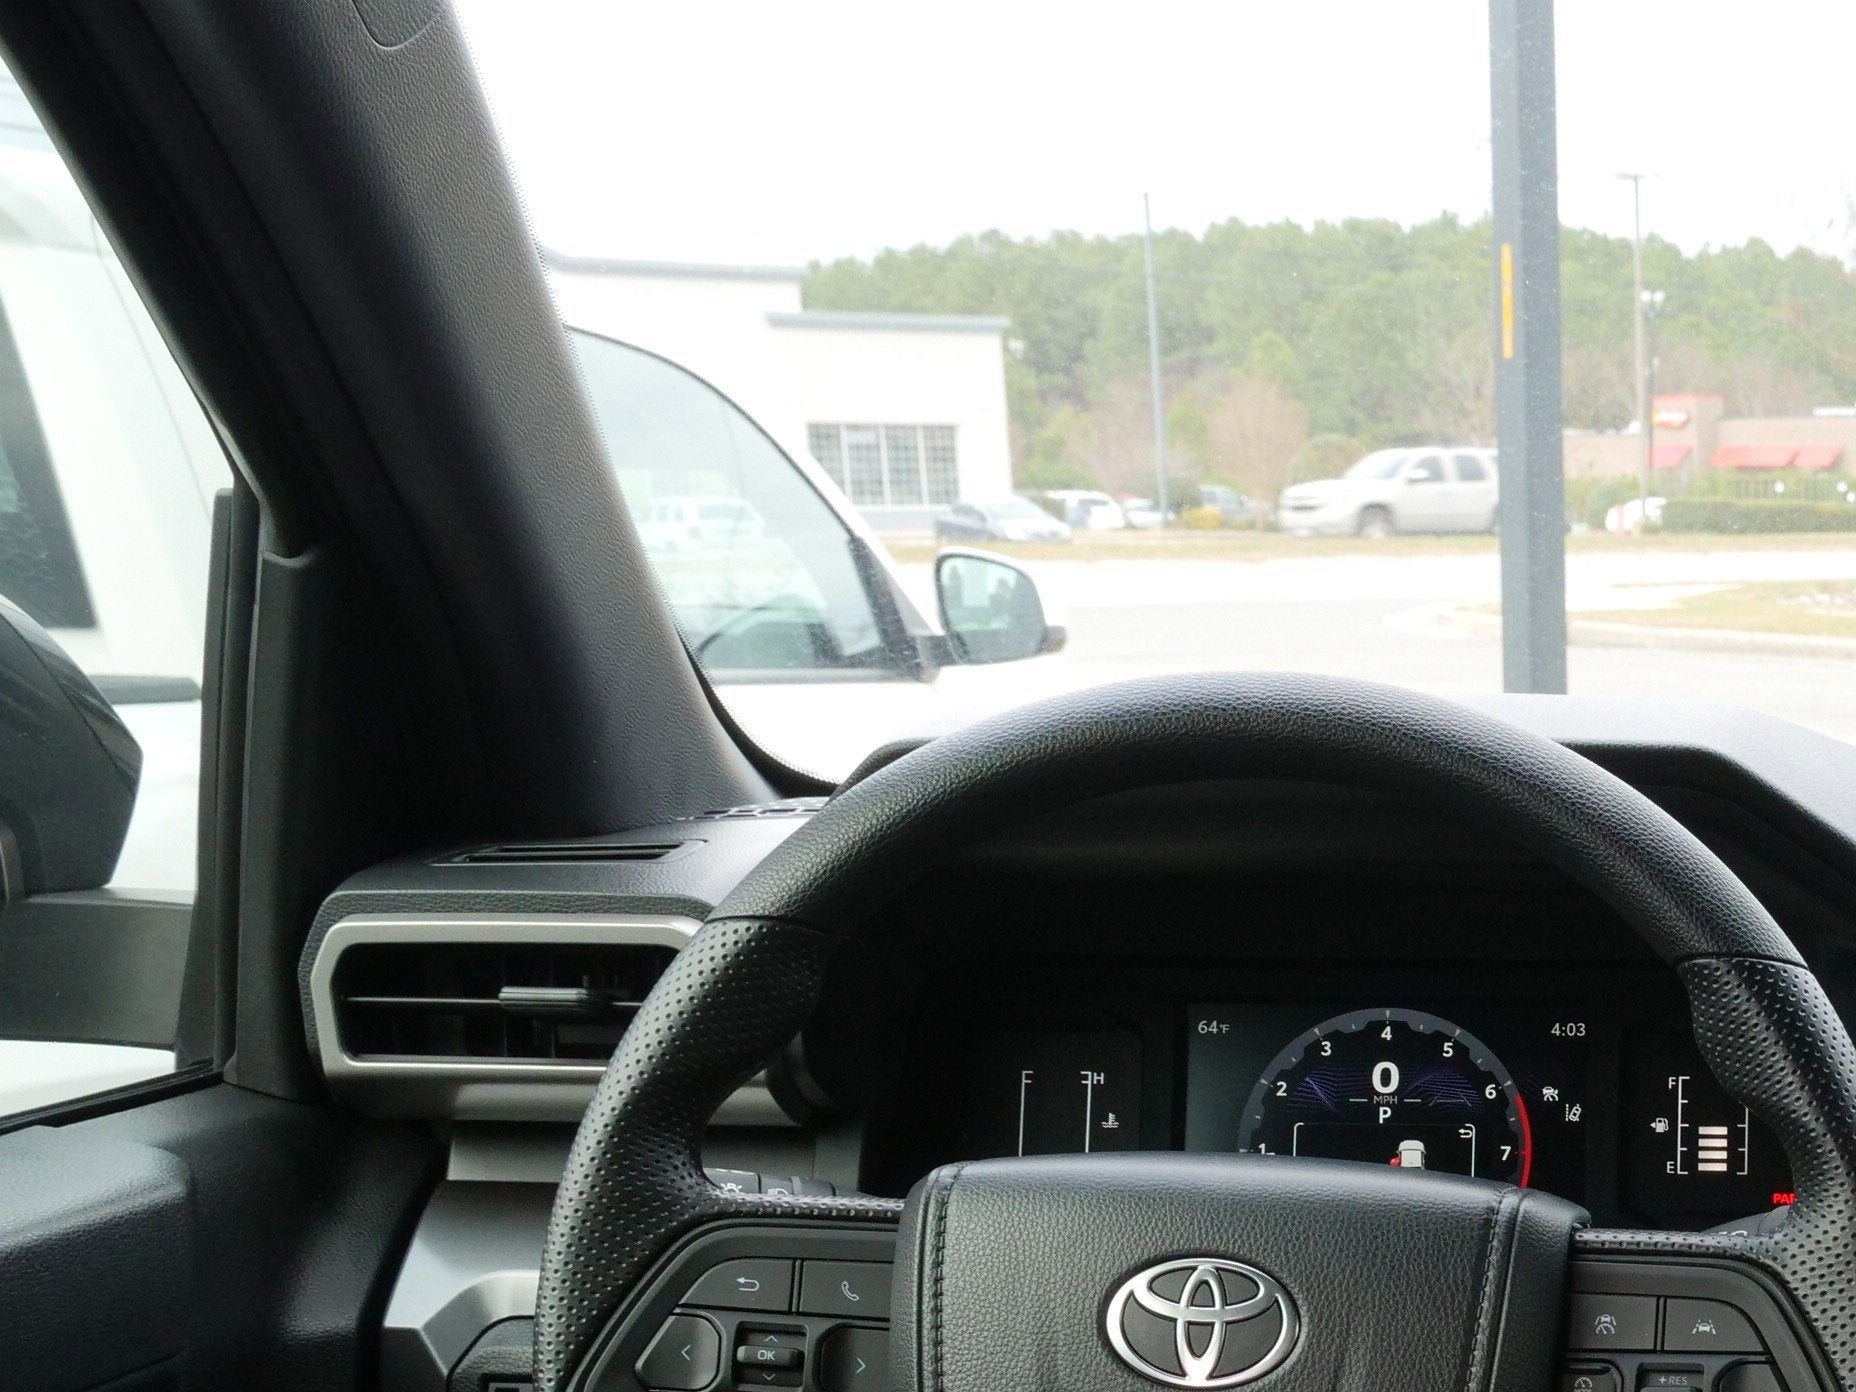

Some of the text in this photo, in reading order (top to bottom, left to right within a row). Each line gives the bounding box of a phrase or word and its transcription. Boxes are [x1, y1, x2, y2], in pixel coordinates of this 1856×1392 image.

[1381, 1026, 1392, 1041] 4
[1551, 1023, 1586, 1037] 4:03
[1320, 1041, 1332, 1056] 3
[1442, 1042, 1454, 1057] 5
[1093, 1072, 1105, 1085] H
[1371, 1061, 1400, 1094] 0
[1668, 1076, 1677, 1089] F
[1275, 1082, 1288, 1097] 2
[1485, 1084, 1497, 1099] 6
[1373, 1095, 1398, 1105] MPH
[1379, 1106, 1392, 1124] P
[1500, 1146, 1511, 1161] 7
[1666, 1161, 1675, 1174] E
[757, 1350, 776, 1361] OK
